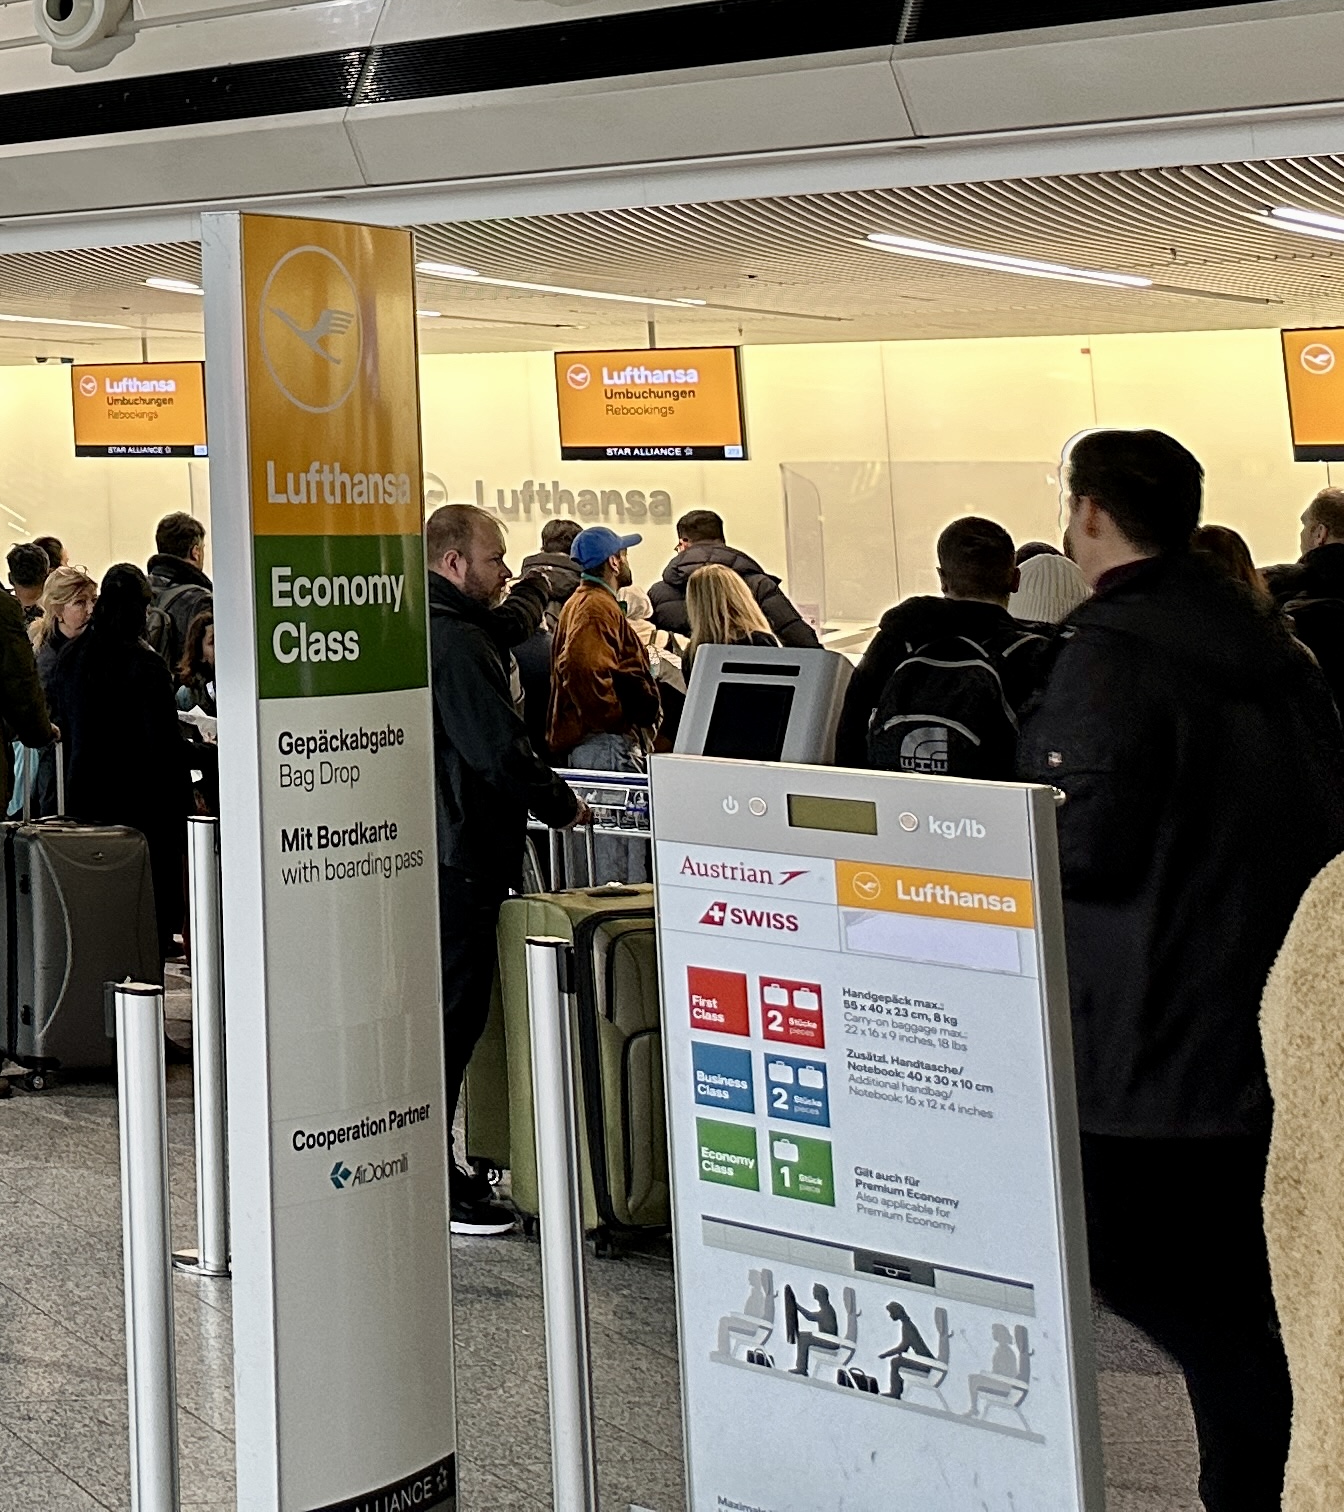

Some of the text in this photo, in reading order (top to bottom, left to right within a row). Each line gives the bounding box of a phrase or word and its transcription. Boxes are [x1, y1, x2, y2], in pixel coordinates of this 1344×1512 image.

[105, 377, 176, 393] Lufthansa
[602, 366, 699, 385] Lufthansa
[107, 396, 174, 407] Umbuchungen
[604, 388, 696, 402] Umbuchungen
[605, 404, 675, 417] Rebookings
[606, 448, 682, 456] STAR ALLIANCE
[266, 460, 411, 505] Lufthansa
[476, 480, 672, 517] Lufthansa
[271, 566, 404, 613] Economy
[272, 621, 360, 664] Class
[278, 724, 404, 759] Gepäckabgabe
[280, 761, 360, 792] Bag Drop
[281, 820, 398, 852] Mit Bordkarte
[928, 816, 987, 840] kg/lb
[281, 849, 424, 885] with boarding pass
[679, 855, 774, 885] Austrian
[896, 879, 1017, 913] Lufthansa
[730, 907, 799, 931] SWISS
[692, 995, 718, 1008] First
[842, 987, 912, 1006] Handgepäck
[692, 1007, 725, 1023] Class
[767, 1009, 784, 1032] 2
[844, 1011, 889, 1027] Carry-on
[891, 1018, 937, 1036] baggage
[859, 1004, 866, 1012] x
[868, 1003, 883, 1014] 40
[885, 1008, 892, 1016] x
[893, 1007, 909, 1018] 23
[910, 1011, 931, 1023] cm,
[943, 1014, 958, 1027] kg
[844, 1024, 858, 1035] 22
[867, 1028, 879, 1038] 16
[881, 1031, 887, 1039] x
[889, 1031, 897, 1040] 9
[898, 1033, 936, 1048] inches,
[938, 1038, 949, 1048] 18
[951, 1040, 968, 1052] lbs
[847, 1061, 905, 1079] Notebook:
[907, 1071, 922, 1082] 40
[925, 1075, 931, 1083] x
[934, 1075, 949, 1086] 30
[960, 1079, 973, 1090] 10
[975, 1083, 994, 1093] cm
[890, 1056, 964, 1075] Handtasche/
[696, 1071, 748, 1089] Business
[697, 1084, 729, 1099] Class
[848, 1074, 953, 1100] Additional handbag/
[772, 1087, 789, 1110] 2
[905, 1095, 917, 1106] 16
[919, 1100, 925, 1108] x
[926, 1099, 937, 1109] 12
[940, 1103, 946, 1111] x
[948, 1103, 956, 1112] 4
[957, 1105, 993, 1119] inches
[292, 1104, 430, 1152] Cooperation Partner
[701, 1146, 755, 1169] Economy
[702, 1159, 734, 1176] Class
[780, 1166, 790, 1188] 1
[854, 1166, 920, 1187] Gilt auch für
[855, 1178, 959, 1209] Premium Economy
[856, 1191, 950, 1218] Also applicable for
[856, 1203, 956, 1234] Premium Economy
